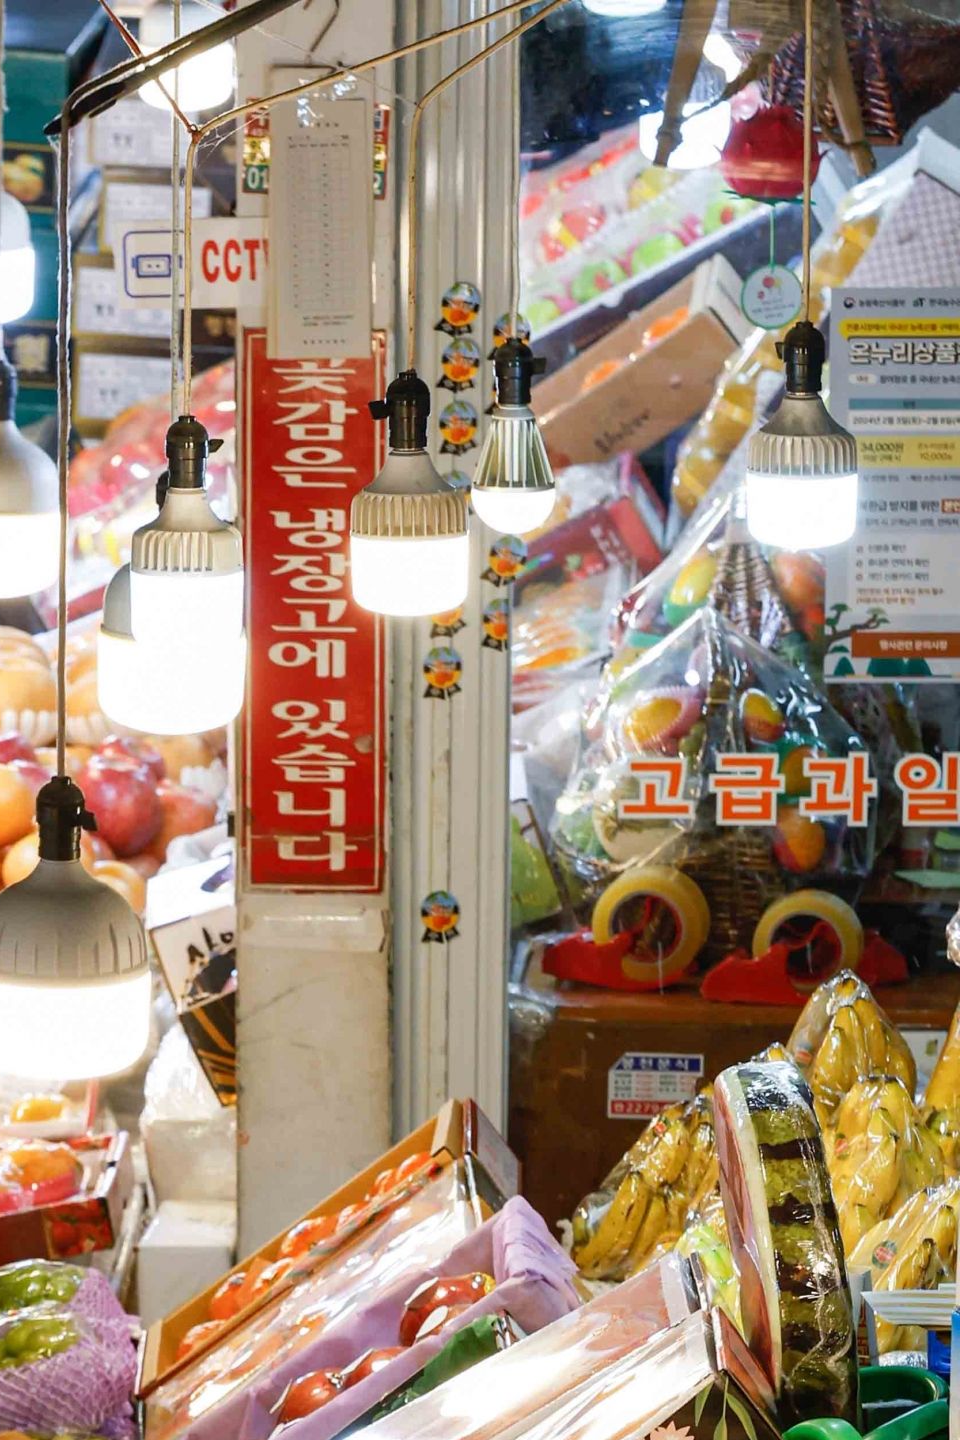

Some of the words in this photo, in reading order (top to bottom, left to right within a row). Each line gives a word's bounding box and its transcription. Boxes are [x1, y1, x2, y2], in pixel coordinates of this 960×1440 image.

[848, 341, 960, 365] 온누리상품
[267, 507, 358, 679] 냉장고에
[271, 698, 359, 872] 있습니다
